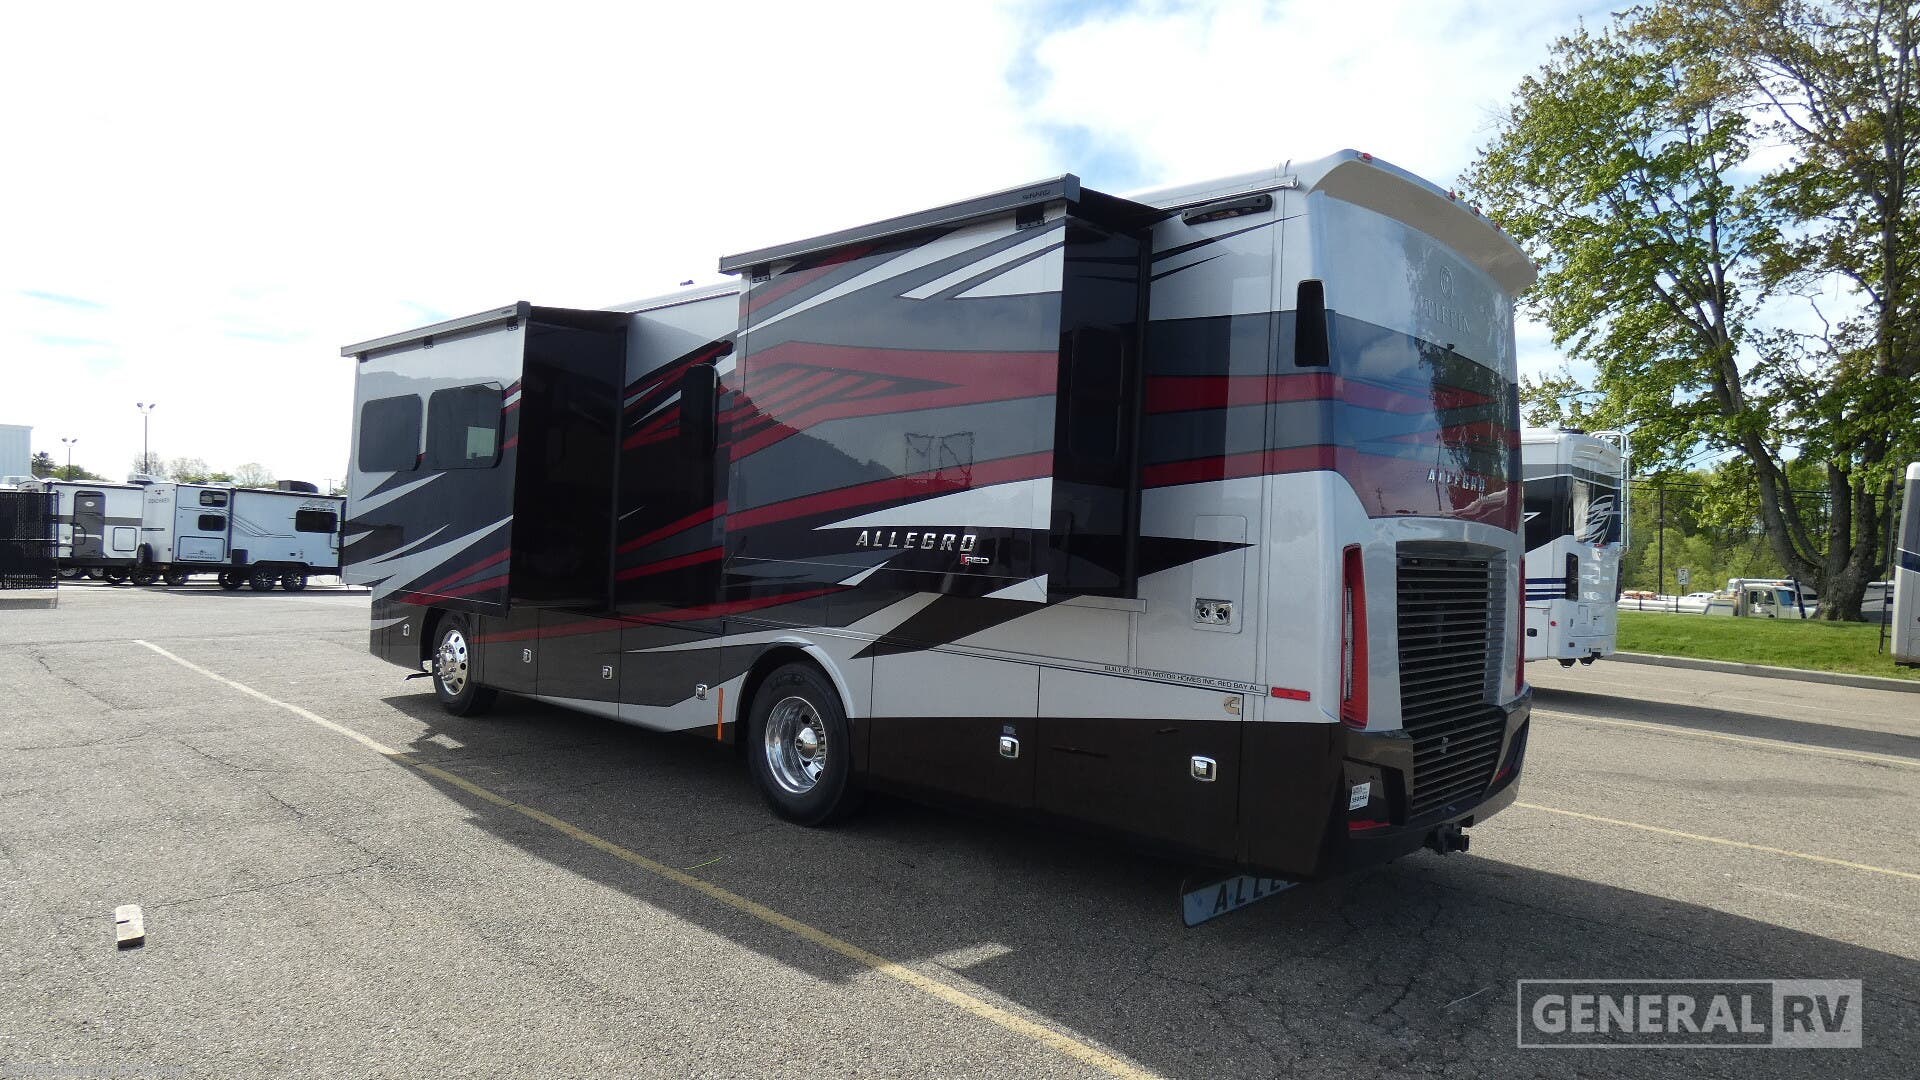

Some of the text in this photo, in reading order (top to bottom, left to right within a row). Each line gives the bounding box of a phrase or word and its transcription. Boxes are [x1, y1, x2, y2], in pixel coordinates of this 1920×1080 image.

[1424, 298, 1470, 334] TIFFIN
[856, 530, 977, 552] ALLEGRO
[963, 556, 990, 564] RED
[1233, 682, 1248, 690] BAY
